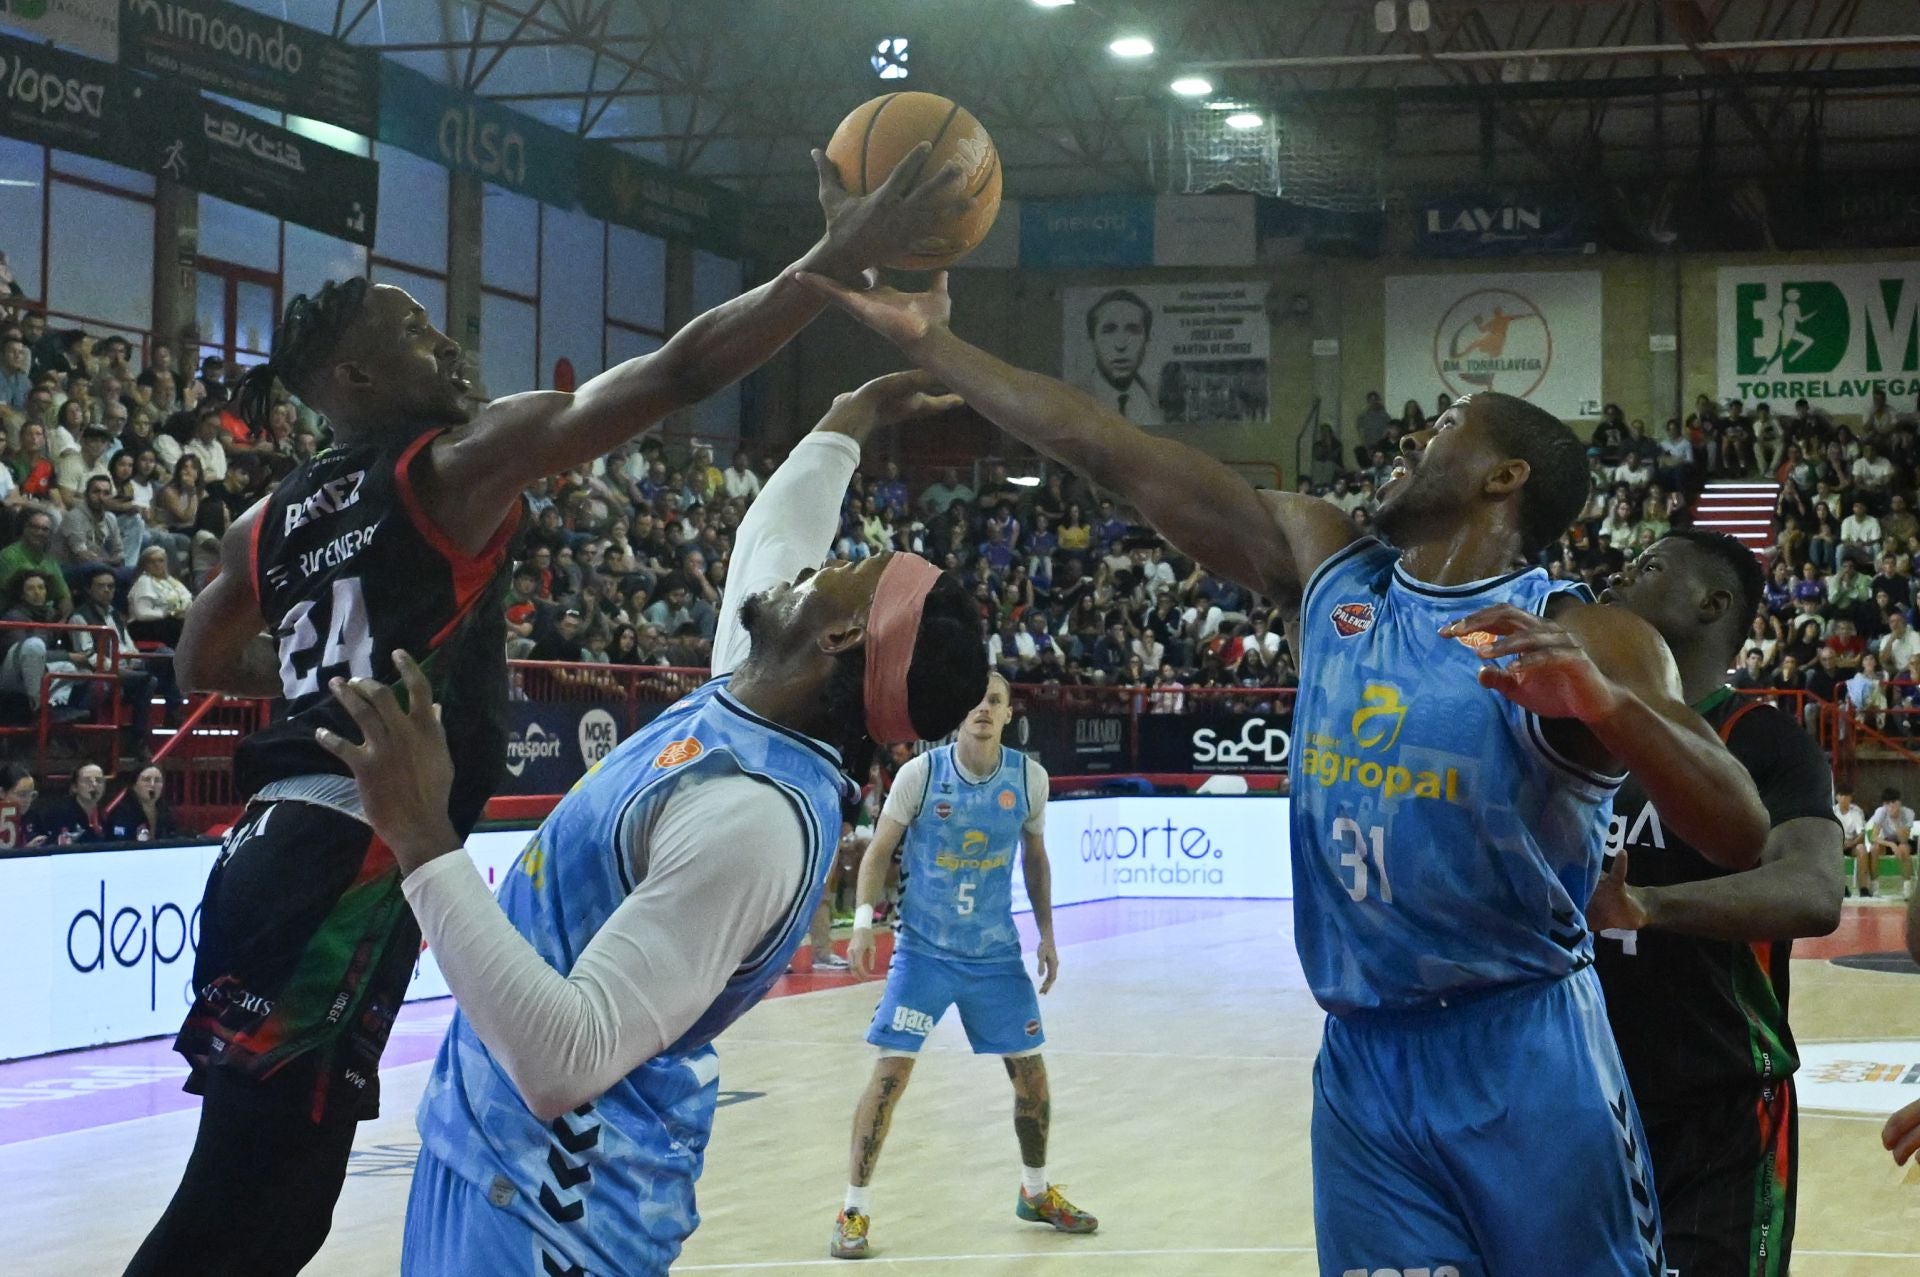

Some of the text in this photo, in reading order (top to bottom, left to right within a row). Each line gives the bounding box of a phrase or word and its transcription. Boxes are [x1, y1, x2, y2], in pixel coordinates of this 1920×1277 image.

[1427, 207, 1541, 233] LAVIN
[1467, 358, 1542, 371] TORRELAVEGA
[1737, 378, 1920, 400] TORRELAVEGA
[278, 576, 375, 700] 24
[585, 722, 612, 742] MOVE
[1302, 748, 1459, 804] agropal
[1332, 817, 1393, 903] 31
[958, 883, 977, 915] 5
